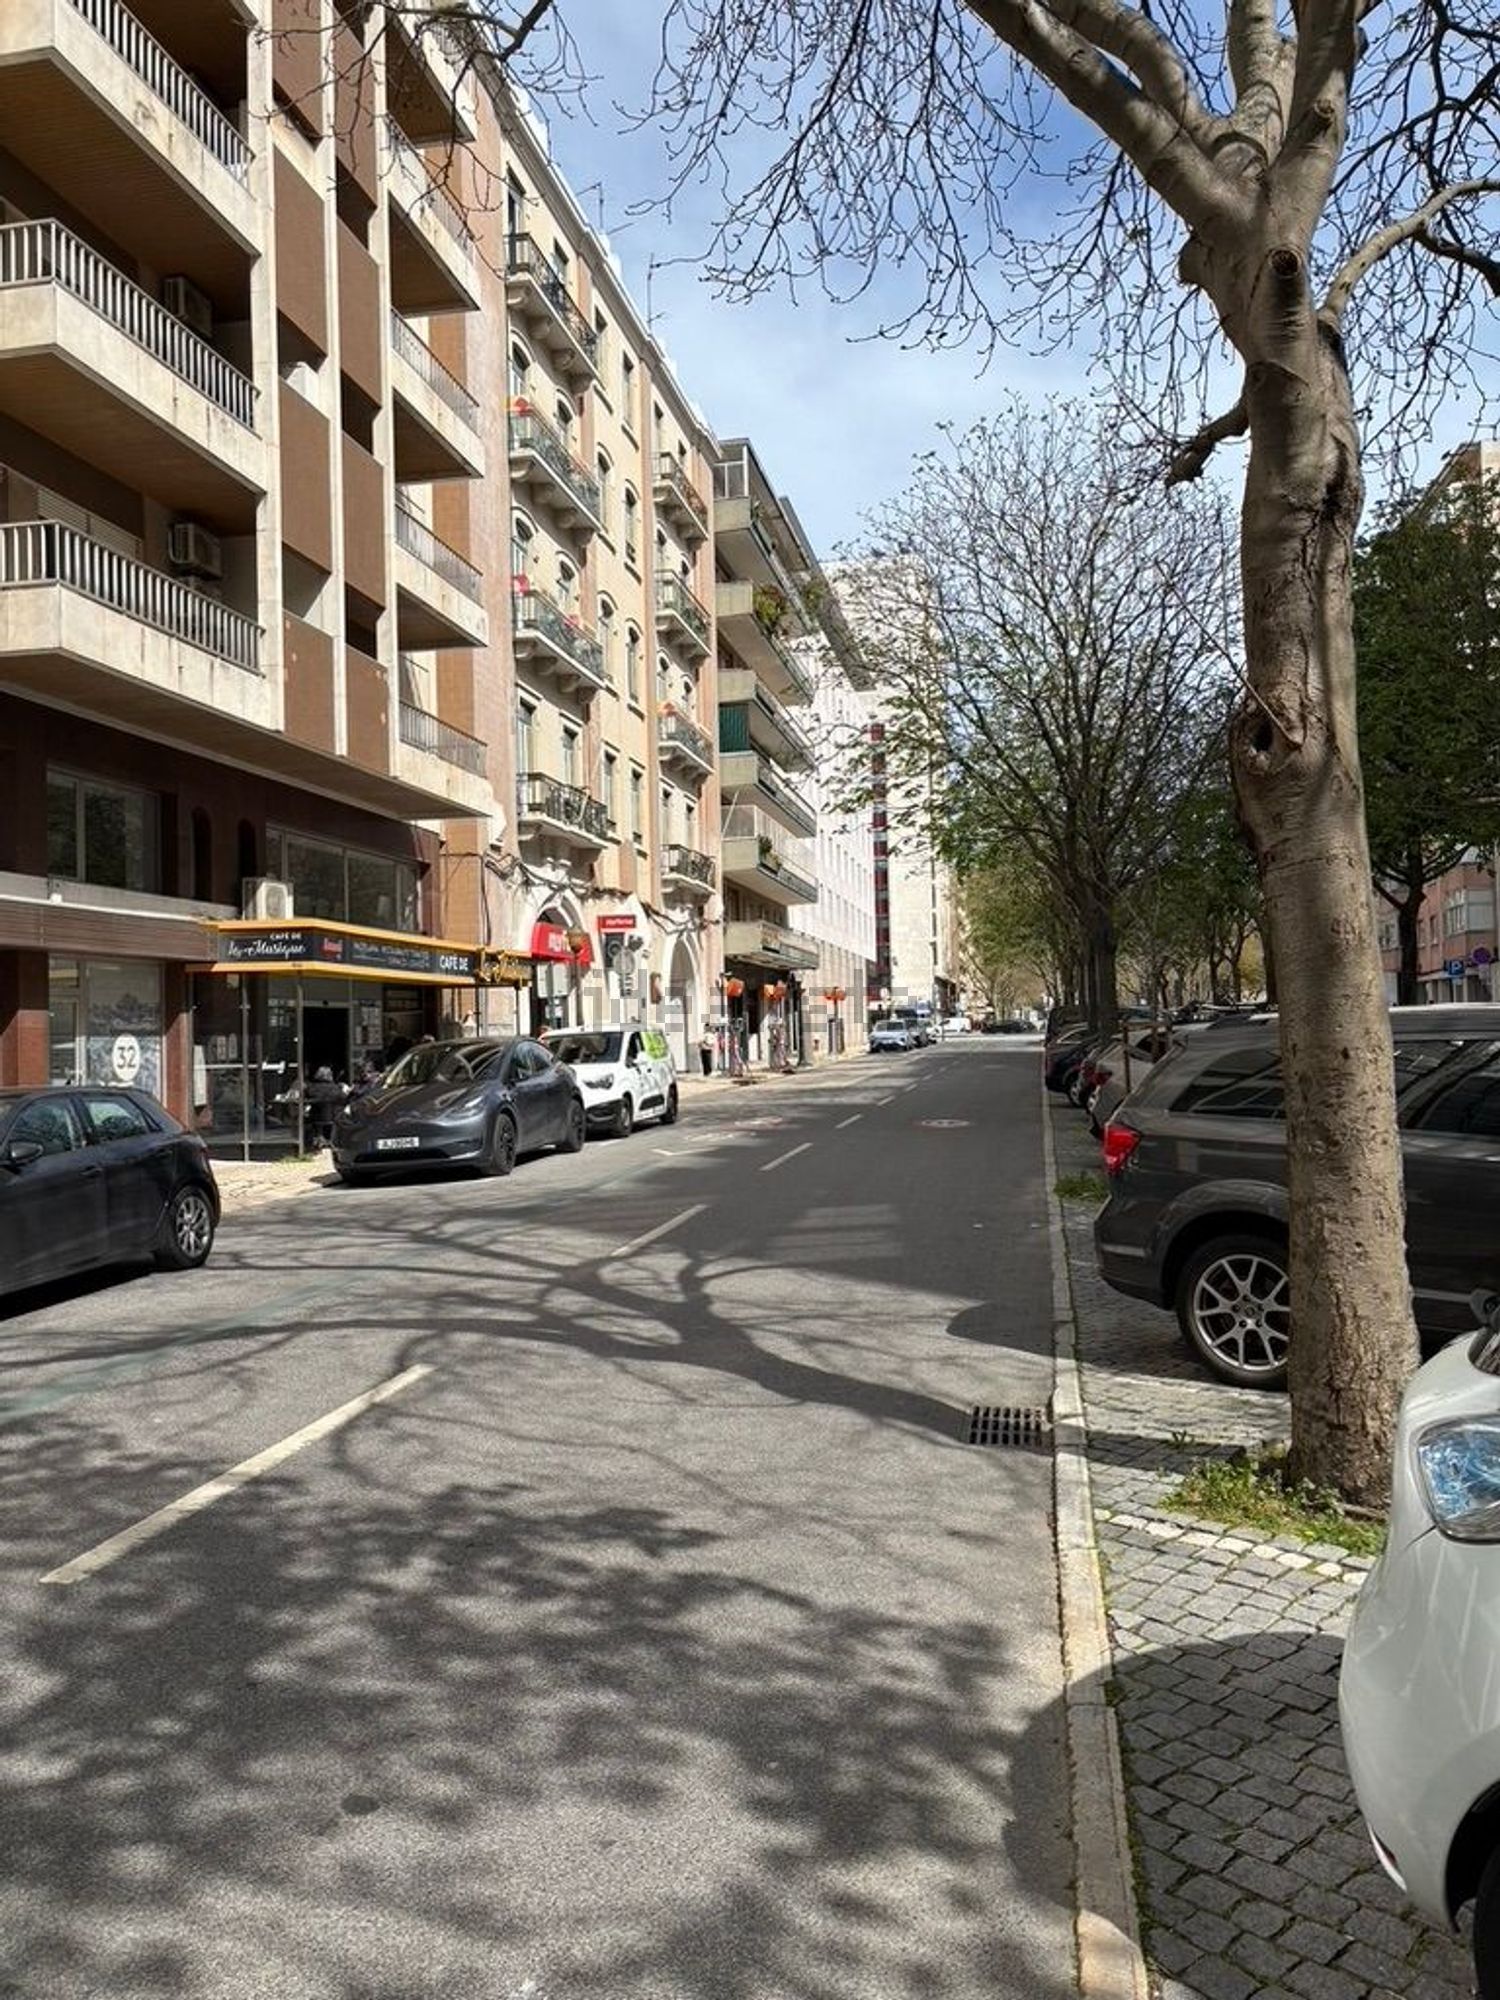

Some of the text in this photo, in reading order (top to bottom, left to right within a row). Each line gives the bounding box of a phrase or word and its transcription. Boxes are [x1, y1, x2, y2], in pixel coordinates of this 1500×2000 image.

[459, 956, 469, 971] DE
[1451, 960, 1462, 974] P
[117, 1045, 136, 1069] 32
